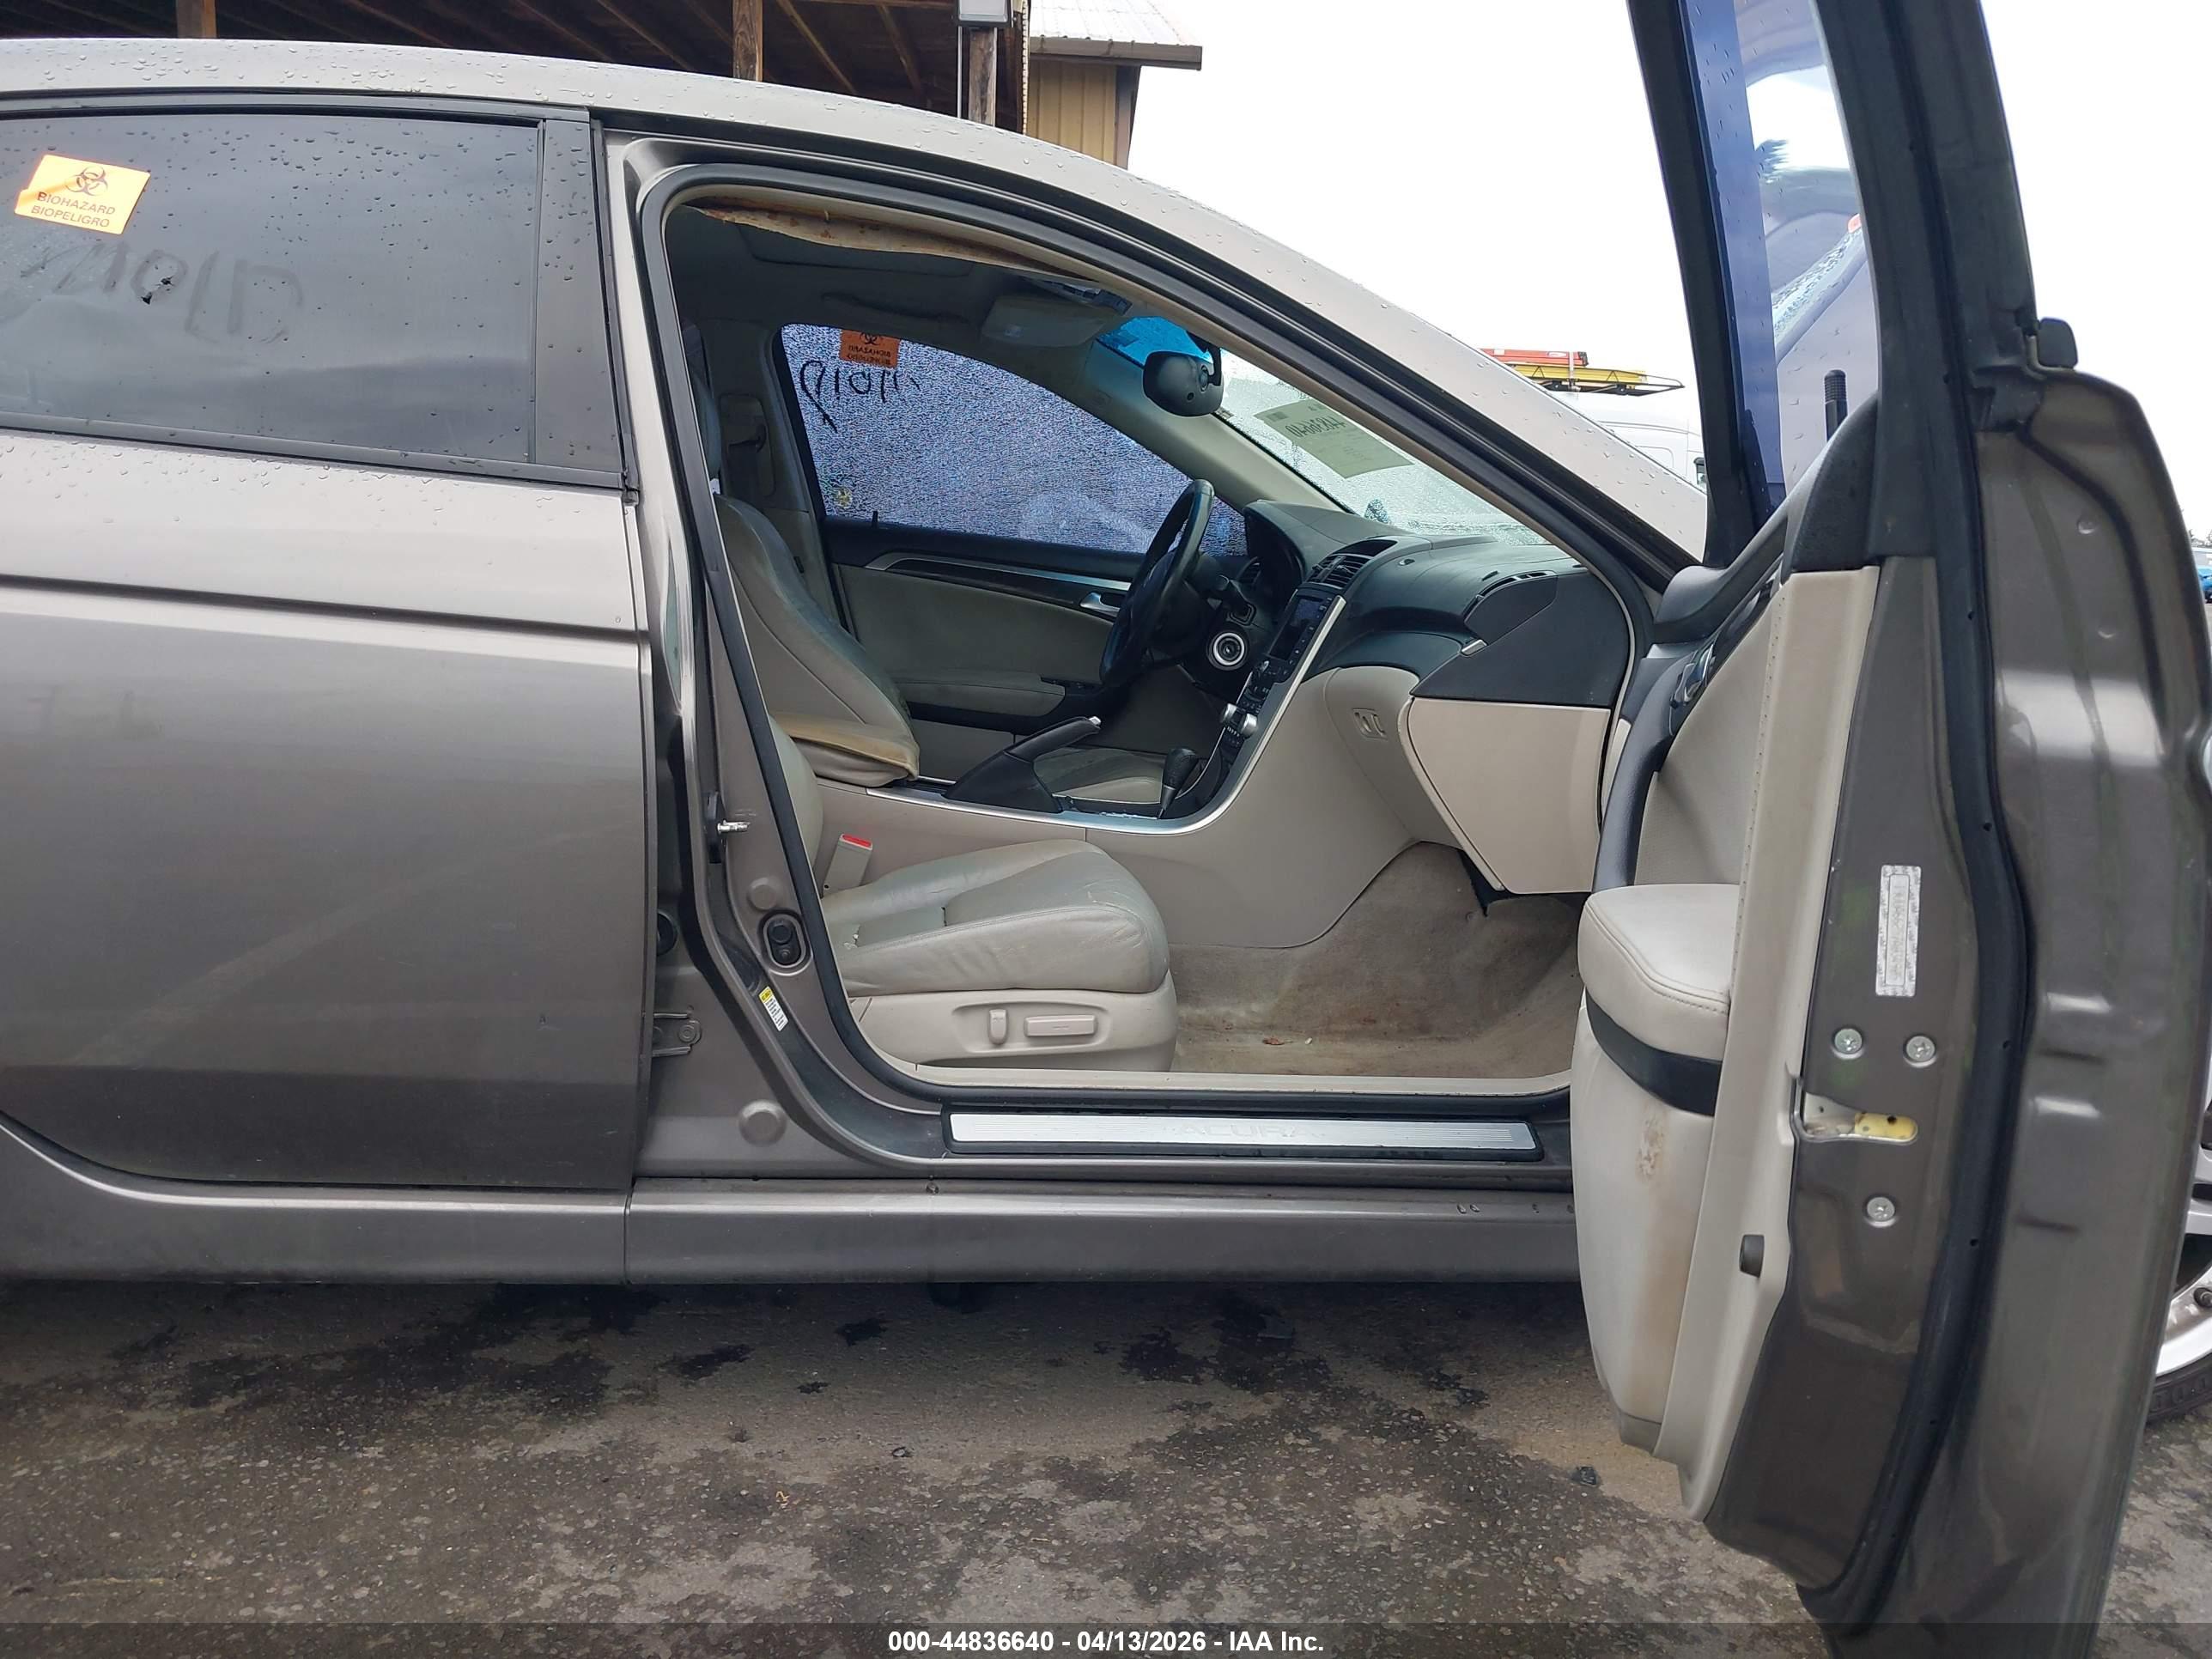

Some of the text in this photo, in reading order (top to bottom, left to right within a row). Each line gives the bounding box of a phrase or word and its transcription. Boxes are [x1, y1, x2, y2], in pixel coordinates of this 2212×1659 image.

[37, 191, 116, 216] BIOHAZARD
[31, 204, 110, 228] BIOPELIGRO
[1175, 1124, 1308, 1138] ACURA
